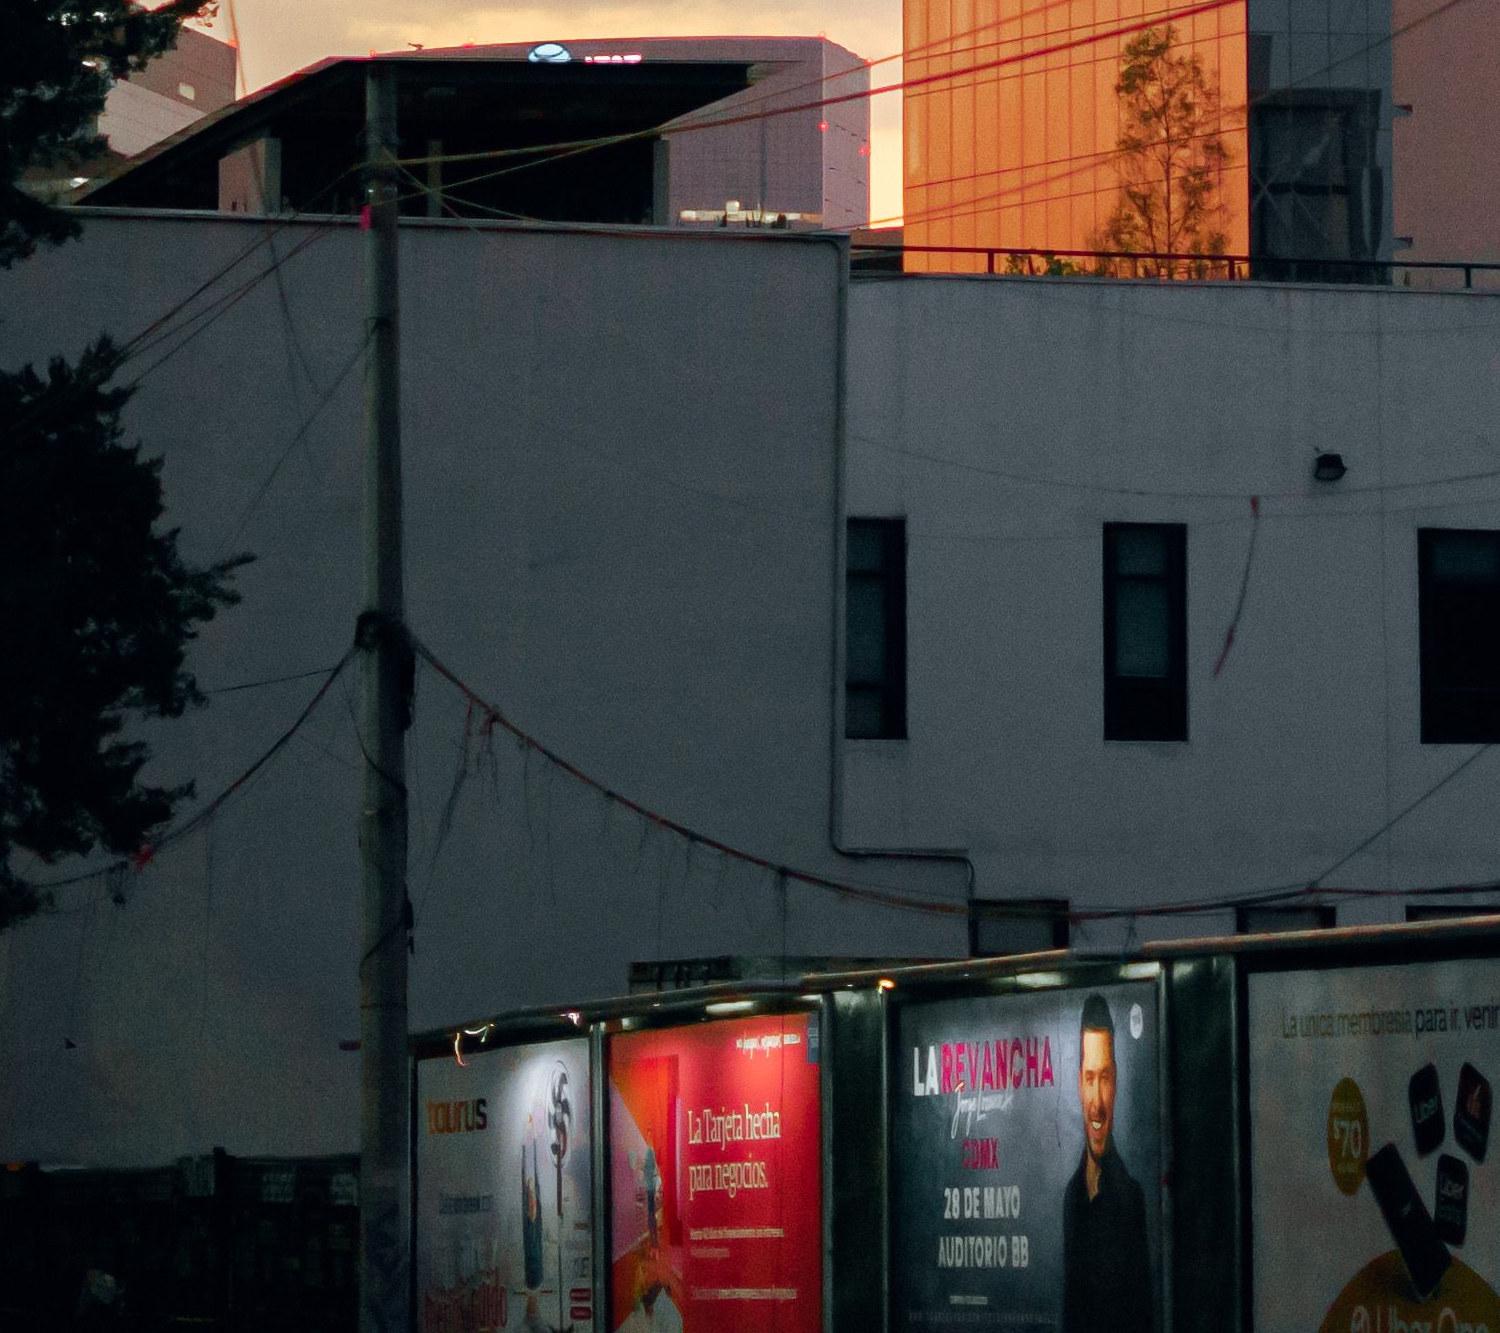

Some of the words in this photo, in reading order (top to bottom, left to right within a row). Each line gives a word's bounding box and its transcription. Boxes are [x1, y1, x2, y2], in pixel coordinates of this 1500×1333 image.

[1415, 1006, 1448, 1039] para
[913, 1046, 940, 1096] LA
[940, 1035, 1056, 1095] REVANCHA
[688, 1110, 702, 1145] La
[703, 1107, 743, 1151] Tarjeta
[744, 1102, 781, 1139] hecha
[688, 1164, 713, 1201] para
[715, 1153, 769, 1199] negocios.
[943, 1187, 960, 1219] 28
[963, 1187, 981, 1219] DE
[983, 1185, 1021, 1220] MAYO
[937, 1235, 1008, 1268] AUDITORIO
